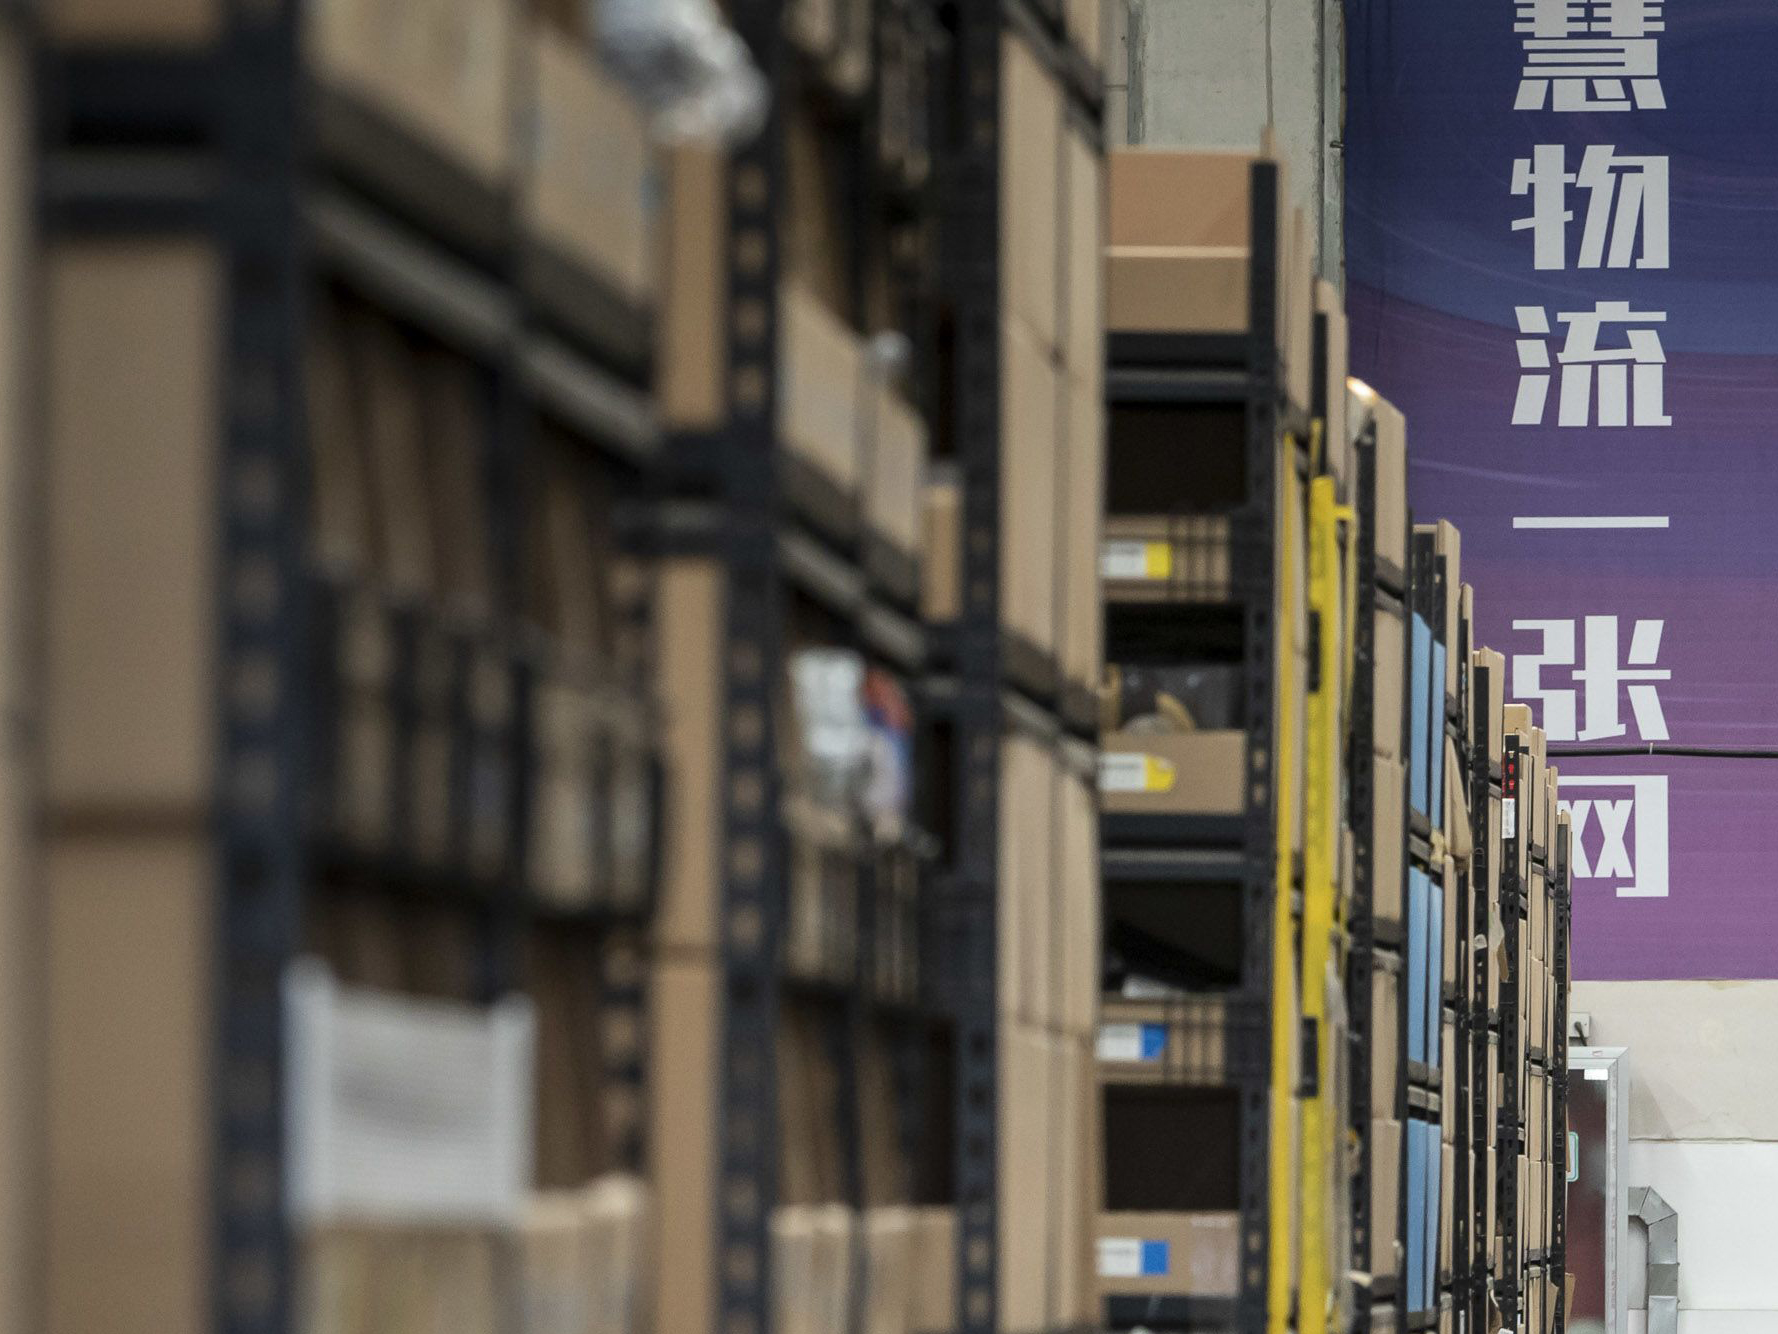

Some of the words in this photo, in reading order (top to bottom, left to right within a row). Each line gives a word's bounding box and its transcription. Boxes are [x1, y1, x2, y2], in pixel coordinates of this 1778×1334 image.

[1511, 0, 1672, 897] 慧物流一张网
